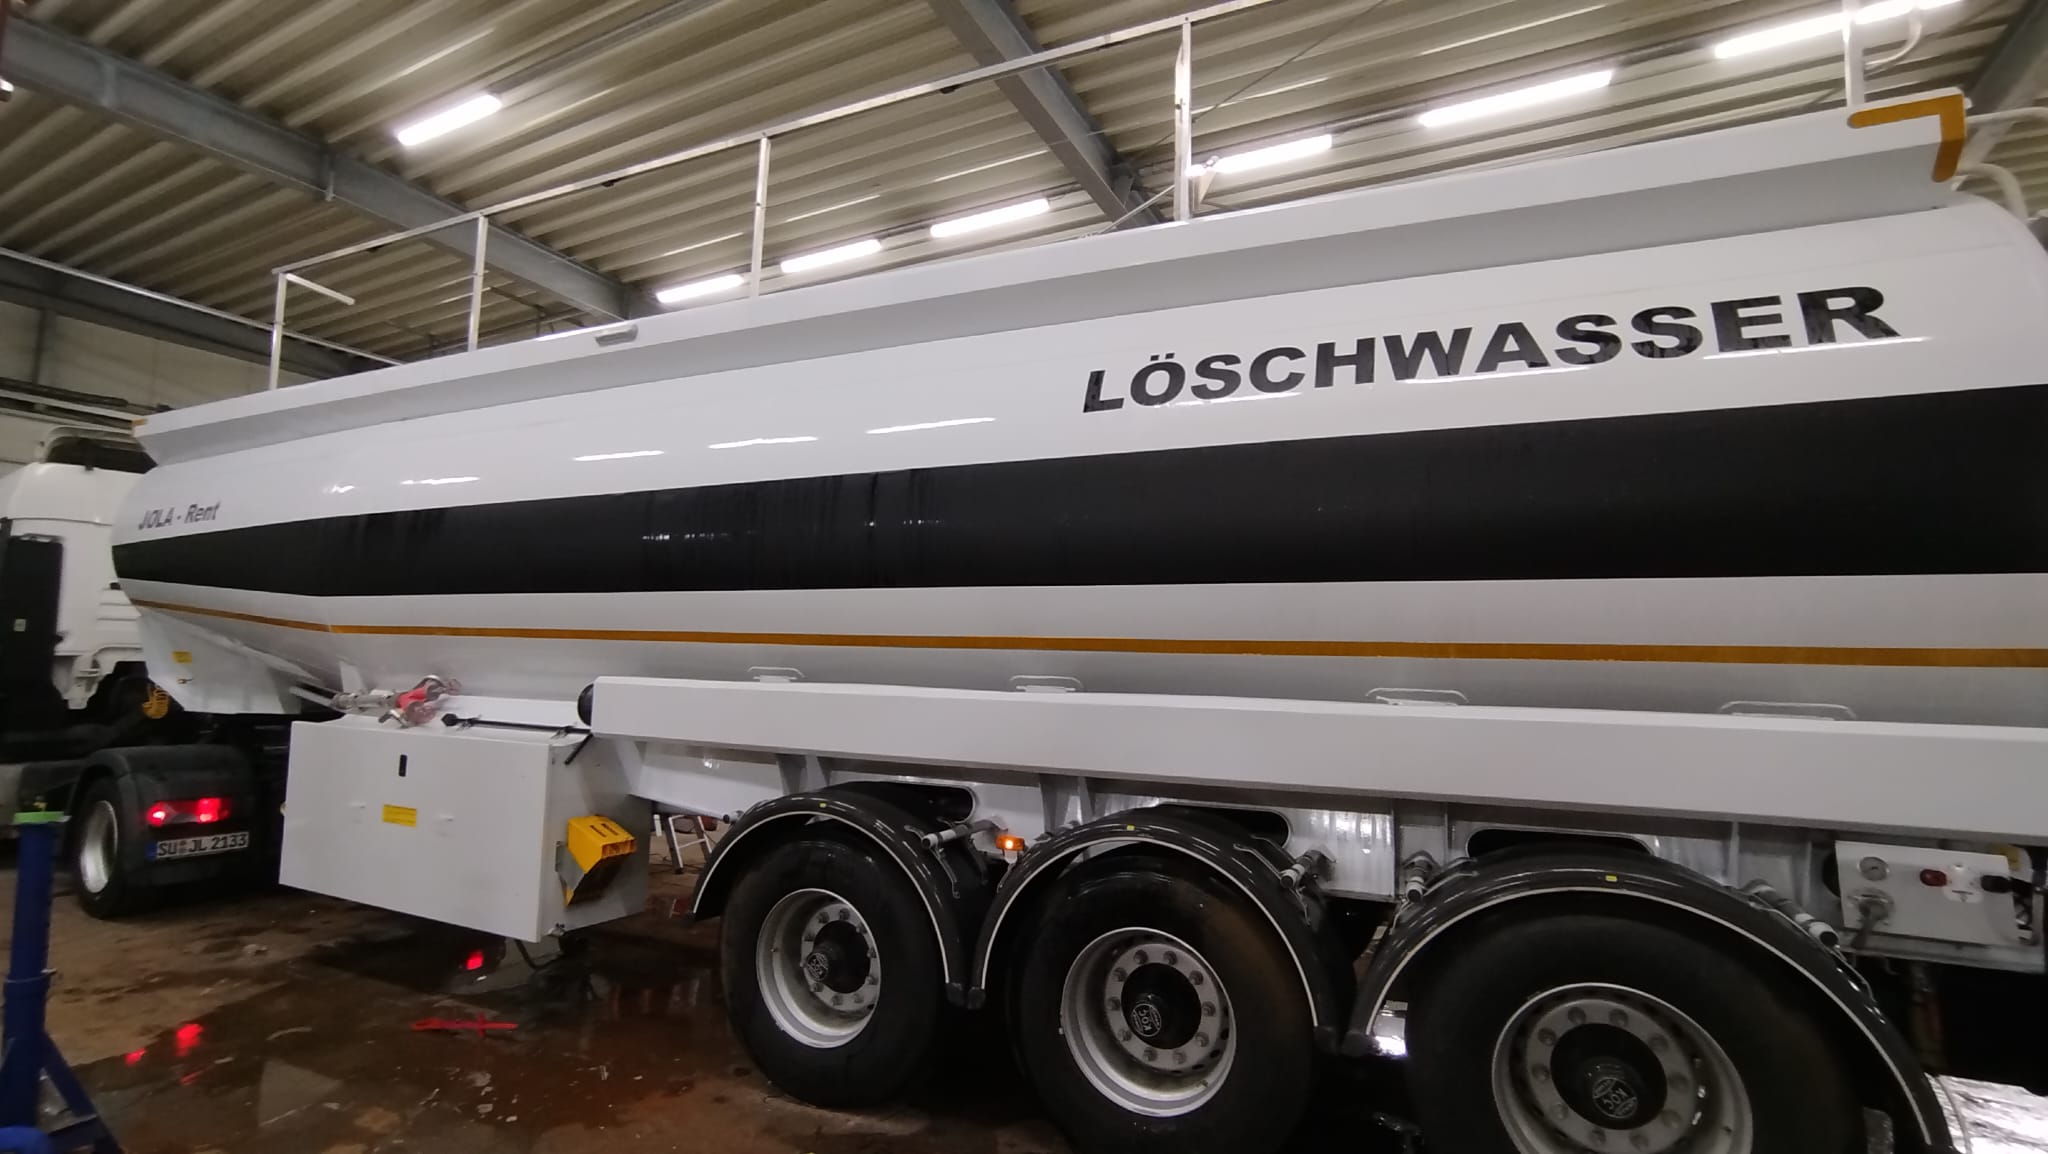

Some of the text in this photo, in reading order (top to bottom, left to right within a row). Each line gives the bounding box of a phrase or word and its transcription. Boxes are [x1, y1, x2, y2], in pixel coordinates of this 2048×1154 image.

[1084, 287, 1900, 412] LÖSCHWASSER
[139, 507, 174, 530] JOLA
[184, 502, 220, 524] Rent
[159, 834, 247, 856] SU JL 2133
